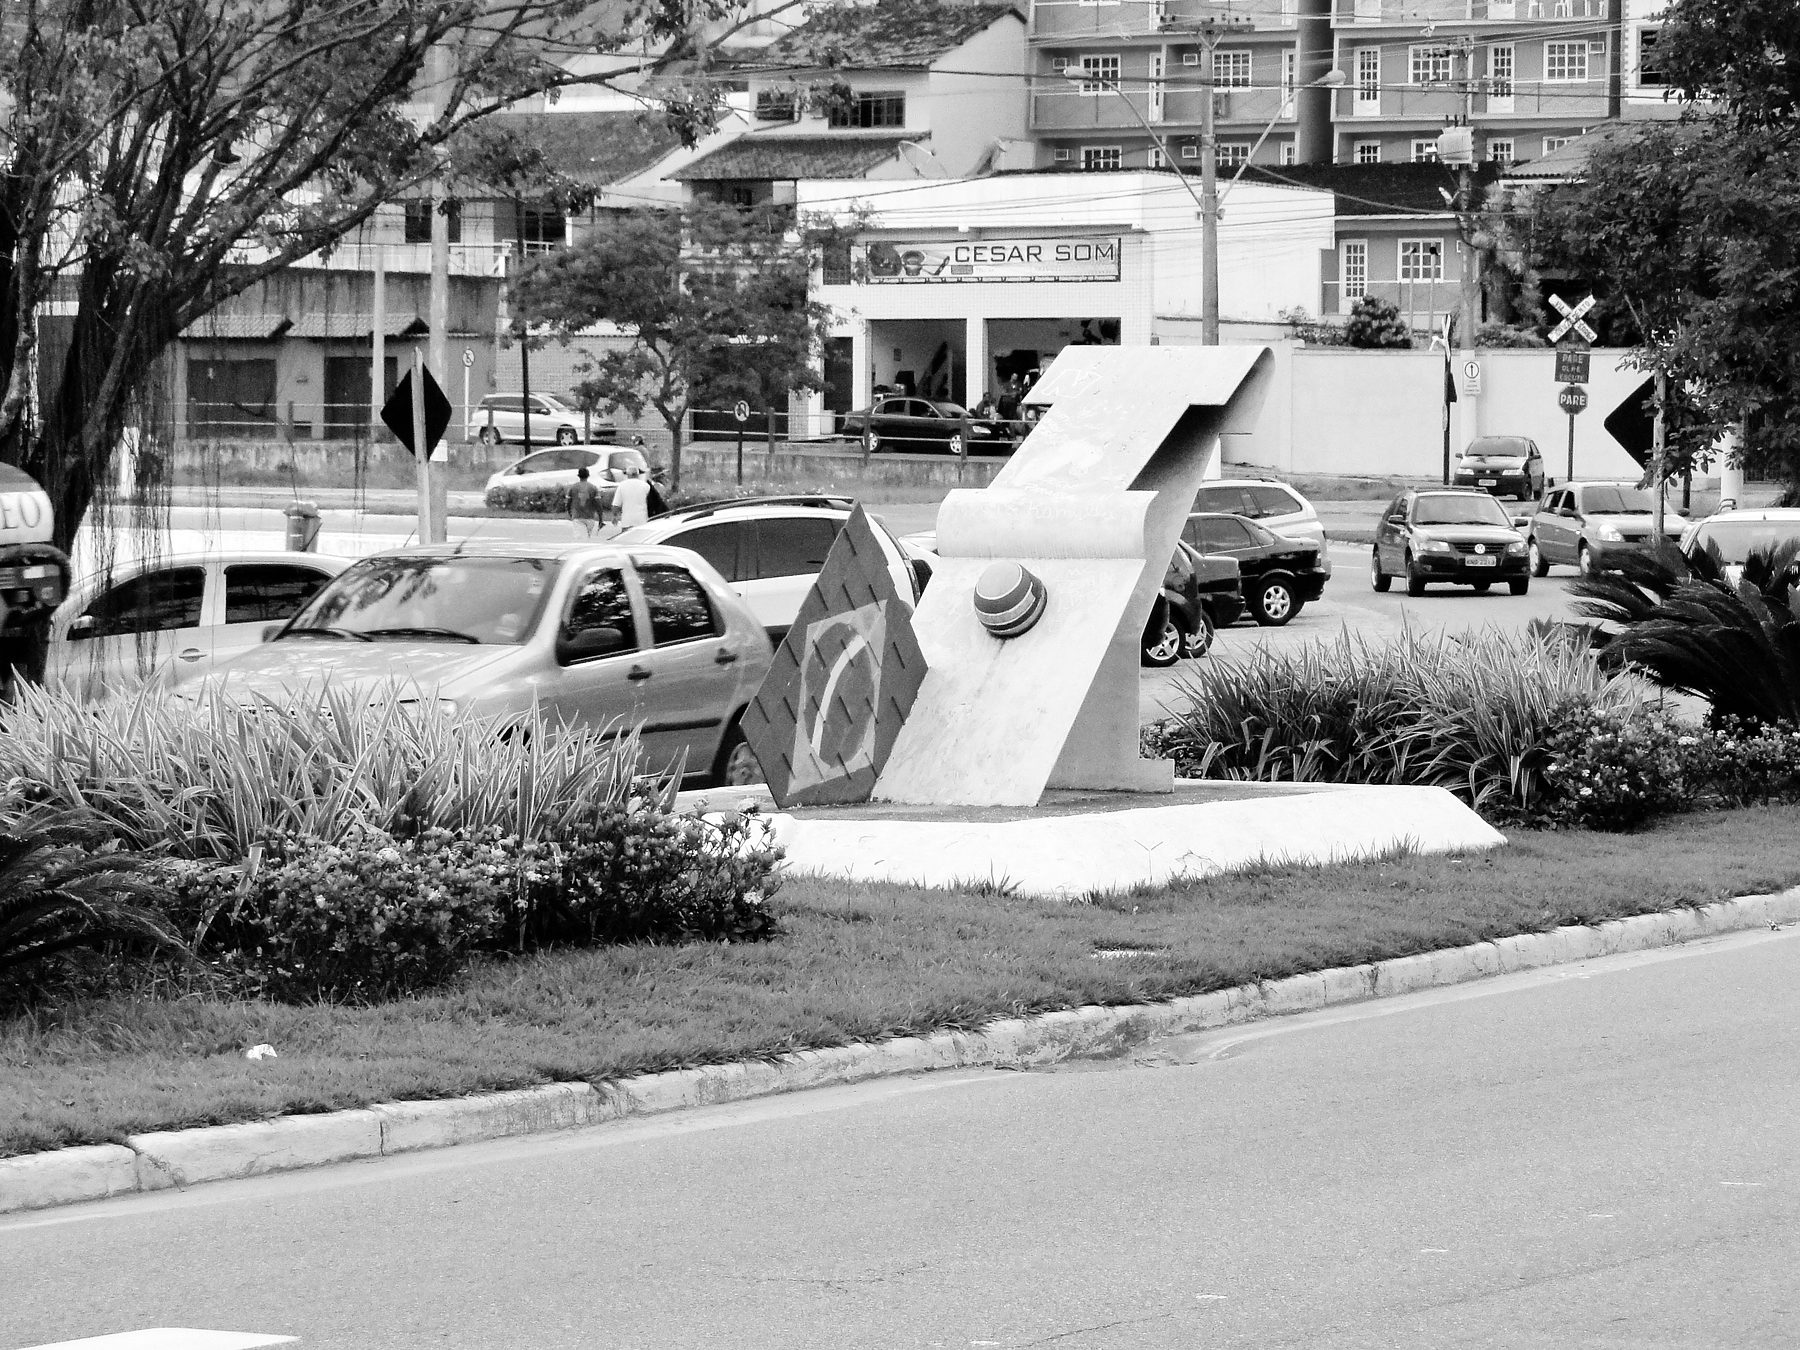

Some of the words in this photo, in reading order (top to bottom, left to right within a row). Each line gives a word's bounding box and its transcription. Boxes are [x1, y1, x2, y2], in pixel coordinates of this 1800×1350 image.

[955, 245, 1042, 263] CESAR
[1055, 243, 1114, 262] SOM
[1562, 353, 1583, 364] PARE
[1560, 394, 1587, 406] PARE
